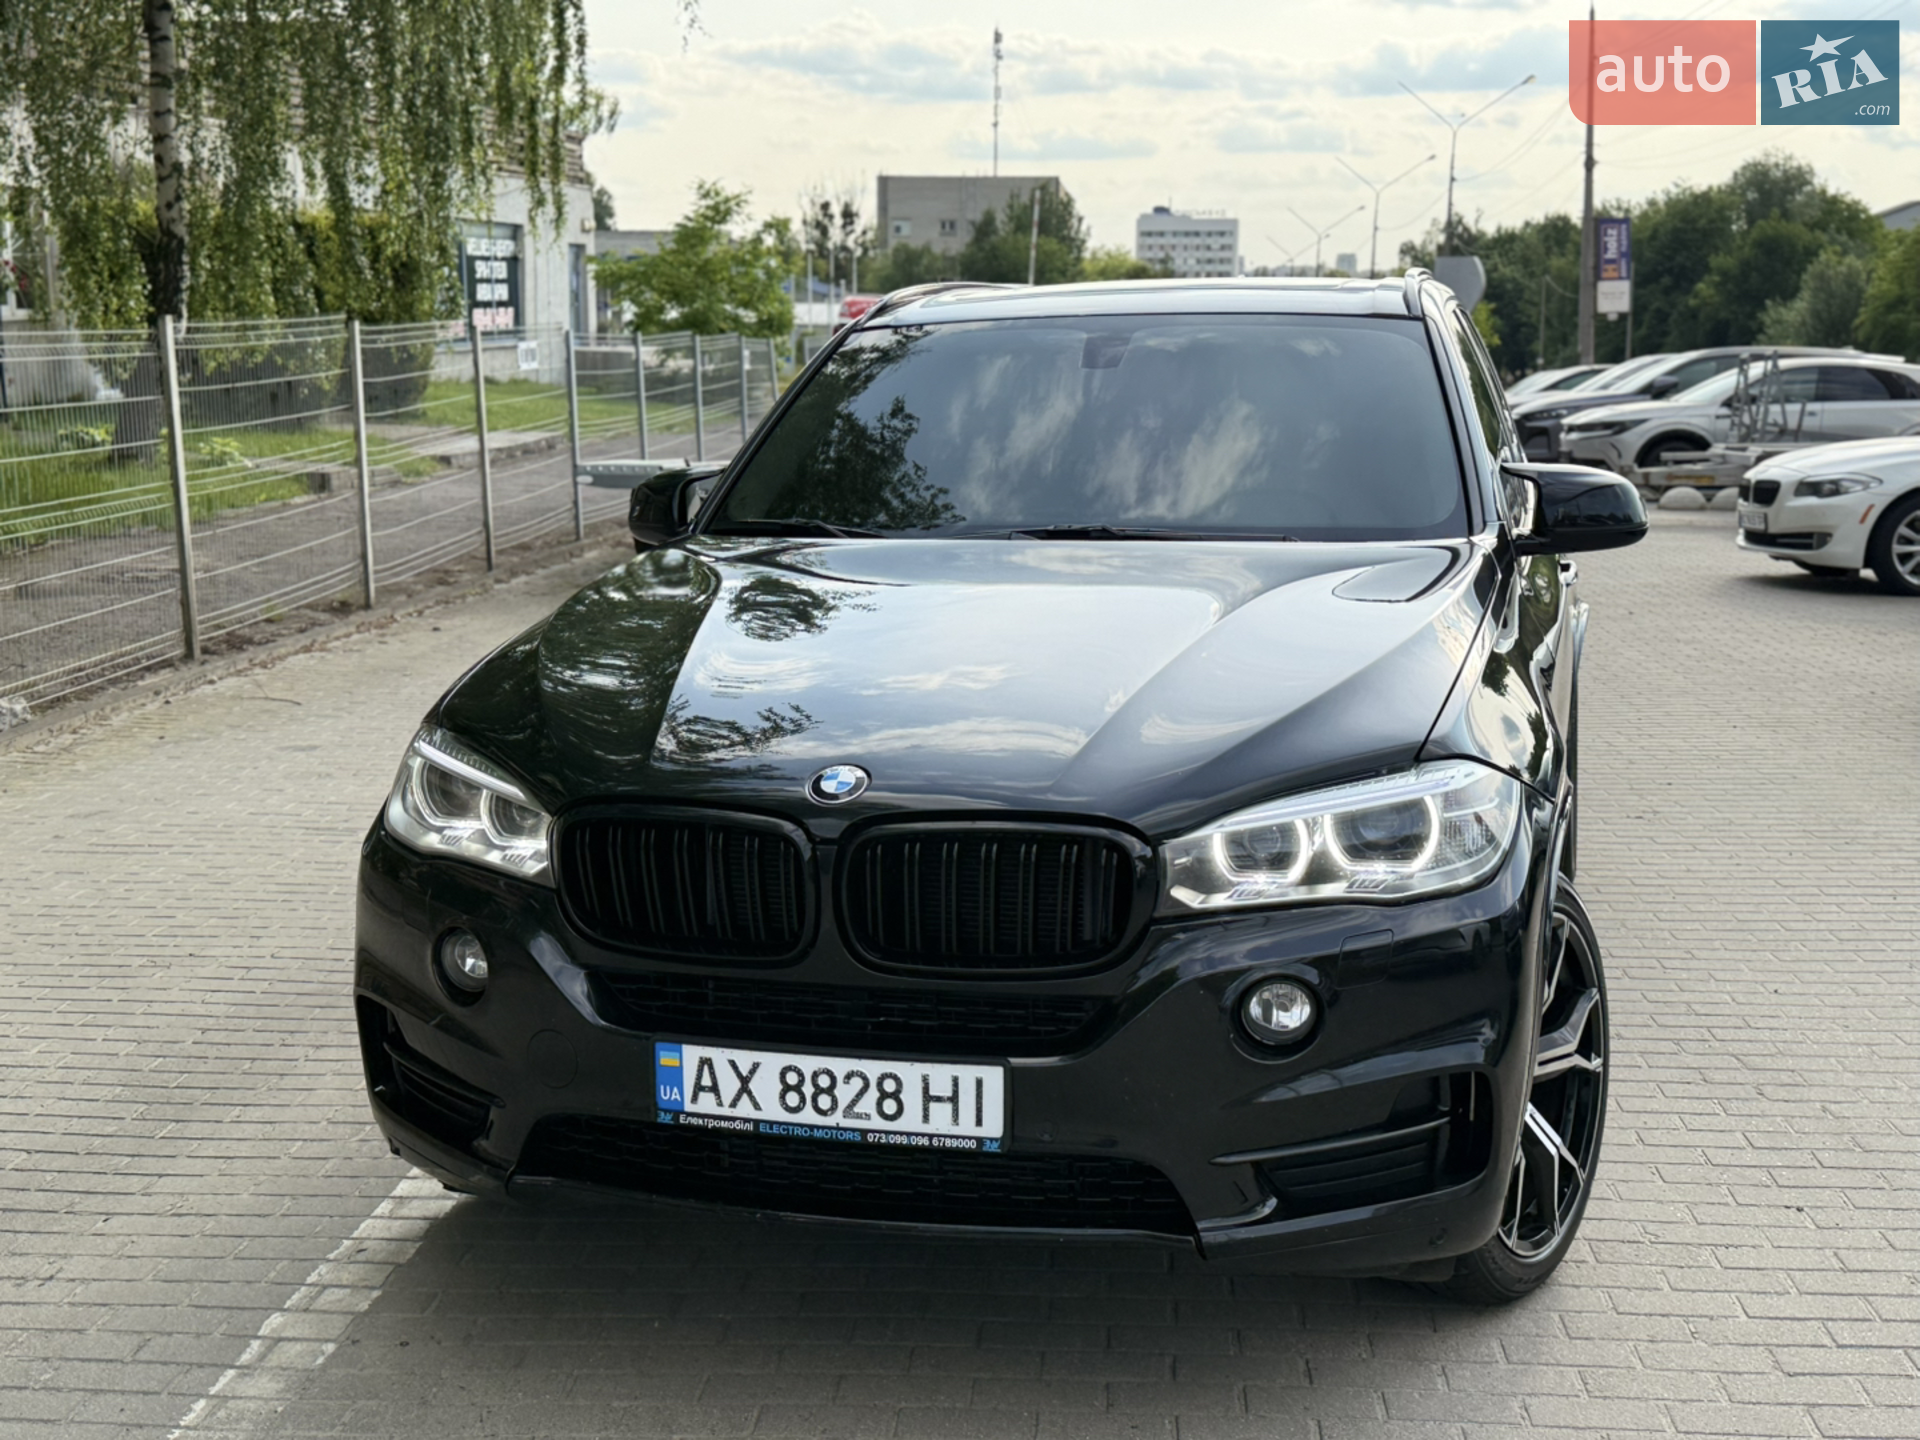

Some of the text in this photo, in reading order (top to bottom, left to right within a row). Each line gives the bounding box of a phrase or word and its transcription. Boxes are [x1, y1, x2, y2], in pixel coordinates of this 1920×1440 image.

[1603, 228, 1618, 259] holz
[660, 1085, 681, 1101] UA
[690, 1056, 983, 1127] AX 8828 HI
[679, 1114, 754, 1132] Електромобілі
[759, 1122, 862, 1142] ELECTRO-MOTORS
[931, 1136, 977, 1149] 6789000
